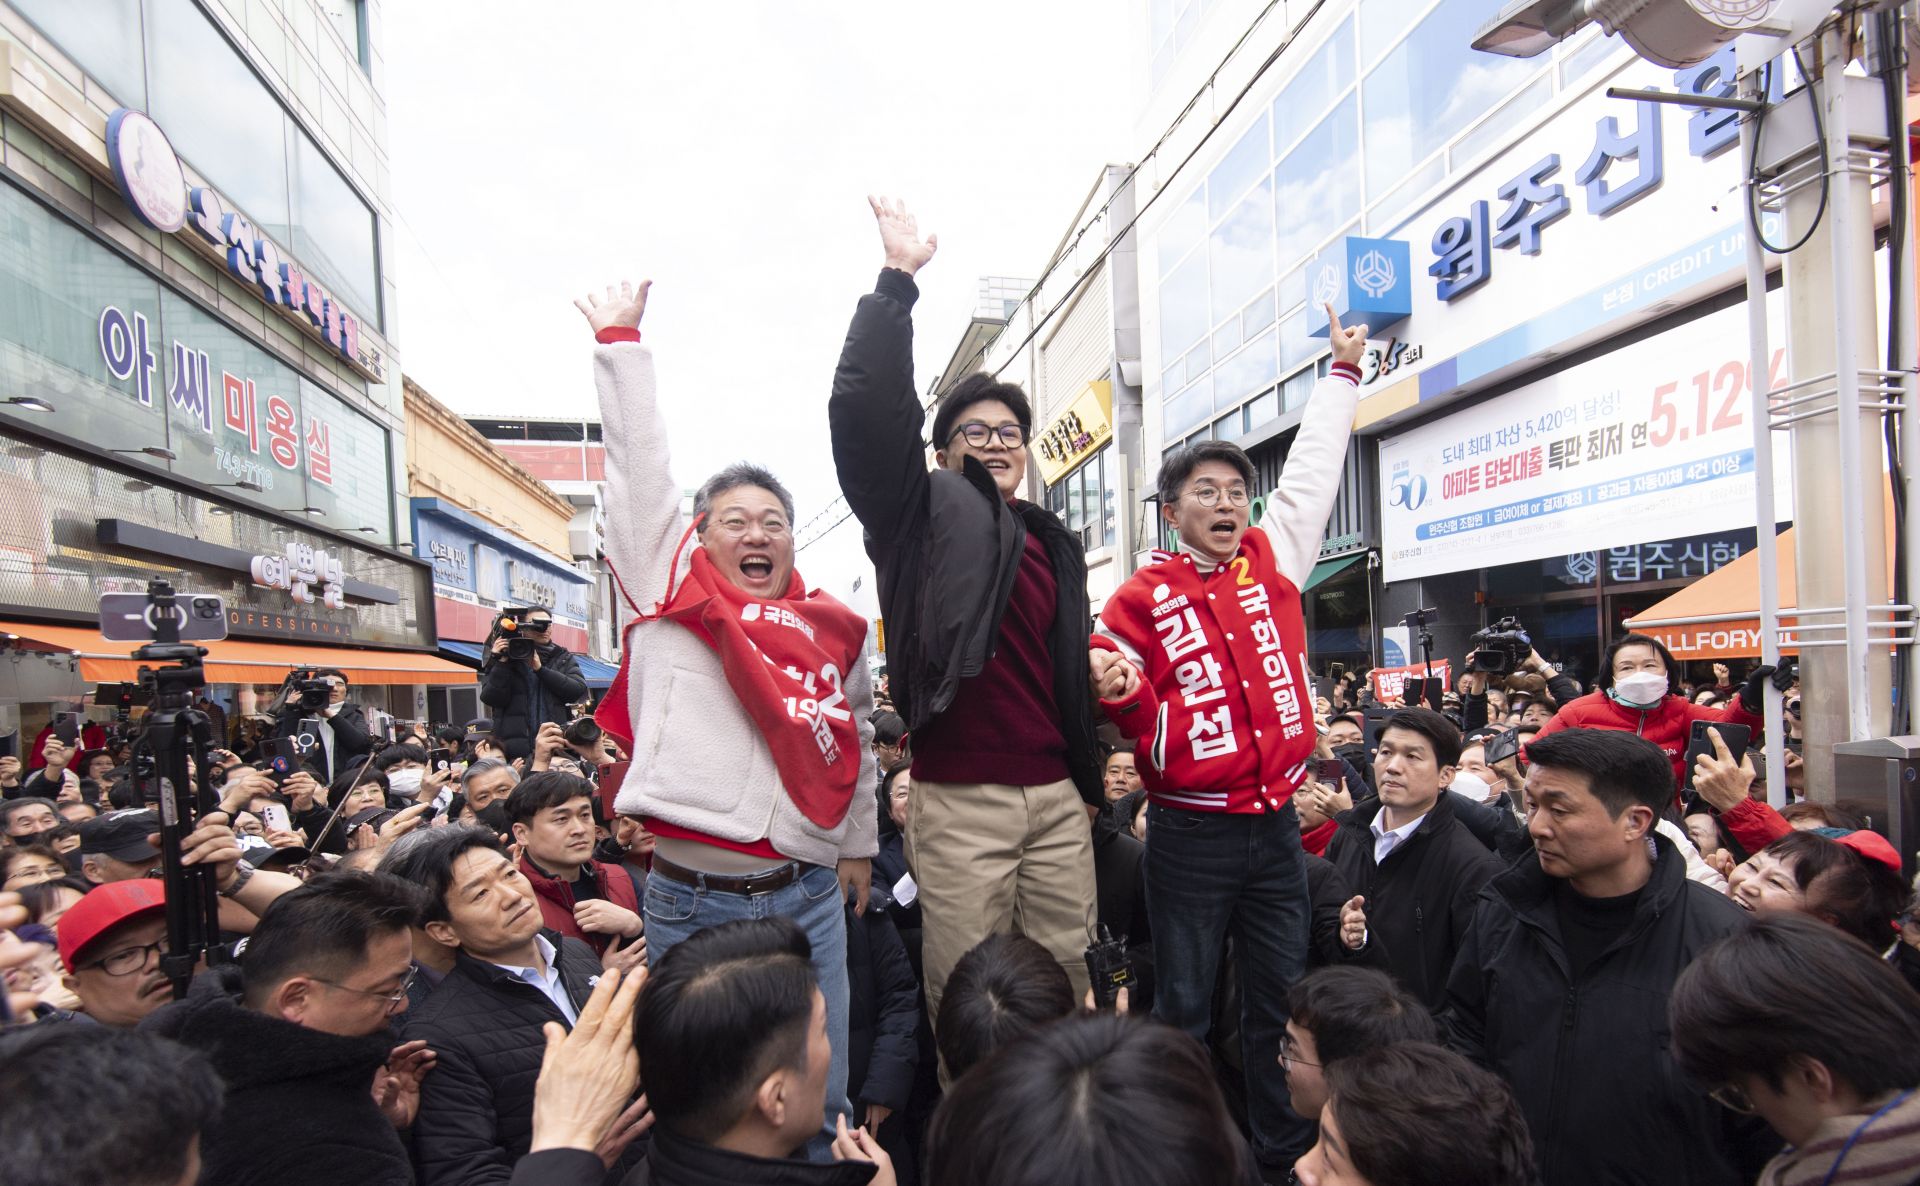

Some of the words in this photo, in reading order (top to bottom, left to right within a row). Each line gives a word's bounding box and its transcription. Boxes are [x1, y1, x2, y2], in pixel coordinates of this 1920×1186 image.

[1643, 244, 1714, 291] CREDIT
[1602, 282, 1634, 311] 본점
[1442, 441, 1465, 465] 도내
[1468, 432, 1492, 456] 최대
[1495, 422, 1521, 448] 자산
[1525, 402, 1577, 439] 5,420억
[1583, 389, 1621, 421] 달성!
[214, 446, 273, 490] 743-7118
[1442, 465, 1480, 500] 아파트
[1484, 445, 1543, 490] 담보대출
[1548, 435, 1582, 471] 특판
[1586, 422, 1624, 462] 최저
[1631, 421, 1648, 449] 연
[1389, 469, 1428, 511] 50
[1428, 519, 1458, 537] 원주신협
[1459, 513, 1483, 531] 조합원
[1494, 503, 1529, 522] 급여이체
[1531, 502, 1541, 513] or
[1598, 481, 1631, 500] 공과금
[1634, 468, 1683, 492] 자동이체
[1686, 460, 1709, 480] 4건
[1712, 454, 1741, 475] 이상
[251, 542, 346, 609] 예쁜날
[1229, 557, 1255, 586] 2
[1609, 541, 1740, 582] 원주신협
[763, 604, 815, 642] 국민의힘
[1151, 594, 1190, 617] 국민의힘
[1236, 583, 1302, 726] 국회의원
[820, 662, 852, 722] 2
[1154, 606, 1239, 761] 김완섭
